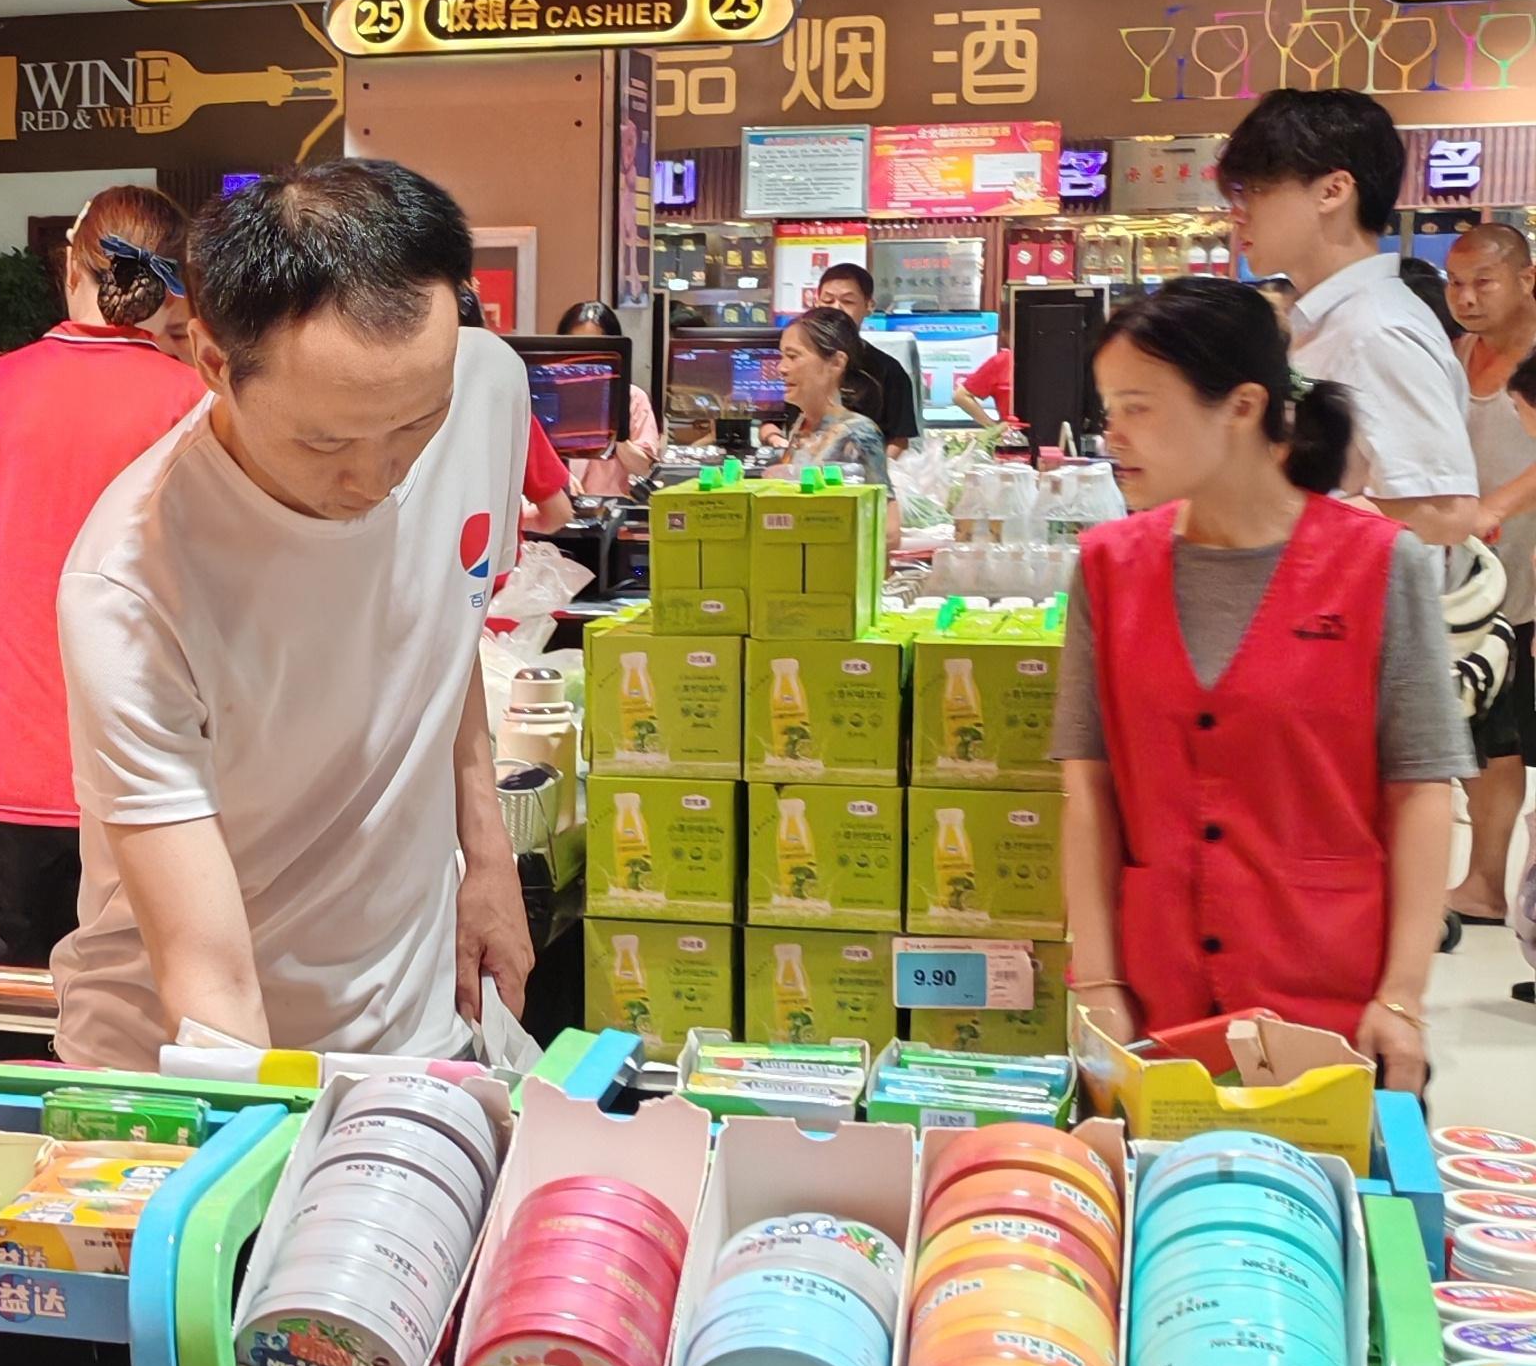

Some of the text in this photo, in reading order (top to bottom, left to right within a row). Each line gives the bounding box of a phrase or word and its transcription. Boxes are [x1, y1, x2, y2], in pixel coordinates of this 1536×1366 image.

[545, 0, 674, 30] CASHIER
[20, 49, 173, 110] WINE
[21, 102, 173, 132] RED & WHITE
[913, 969, 957, 987] 9.90
